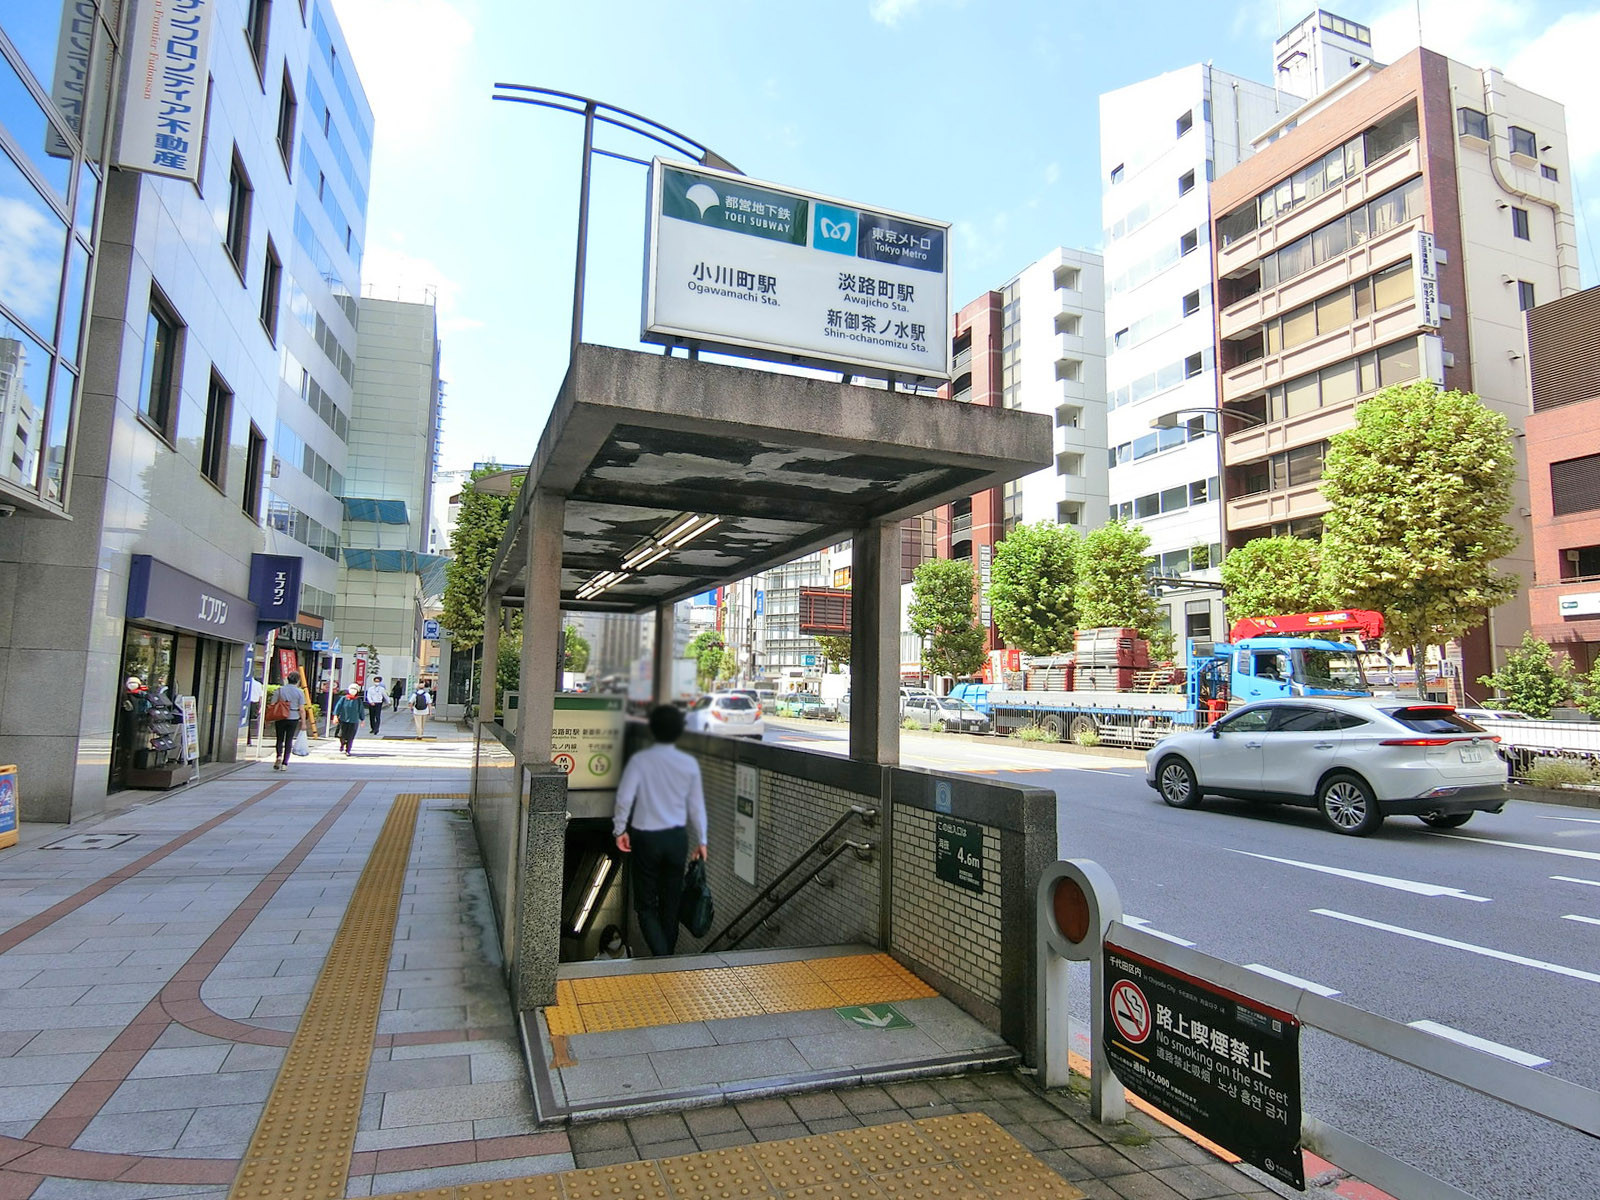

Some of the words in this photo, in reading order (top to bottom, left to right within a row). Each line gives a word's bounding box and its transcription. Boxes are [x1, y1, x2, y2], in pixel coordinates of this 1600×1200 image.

[149, 10, 164, 52] Frontier
[144, 52, 159, 100] Fudousan
[724, 195, 791, 221] 都営地下鉄
[724, 212, 747, 224] TOEI
[749, 216, 791, 234] SUBWAY
[871, 227, 931, 250] 東京メトロ
[875, 242, 901, 256] Tokyo
[901, 248, 928, 261] Metro
[692, 261, 777, 295] 小川町駅
[838, 272, 914, 303] 淡路町駅
[687, 281, 758, 303] Ogawamachi
[761, 295, 781, 307] Sta.
[843, 293, 889, 309] Awajicho
[891, 301, 910, 313] Sta.
[824, 327, 908, 350] Shin-ochanomizu
[910, 342, 929, 353] Sta.
[827, 308, 926, 342] 新御茶ノ水駅
[271, 571, 287, 606] エフワン
[198, 594, 229, 624] エフワン
[241, 643, 253, 725] エフワン
[957, 847, 980, 868] 4.6m
[1109, 956, 1142, 978] 千代田区内
[1156, 1003, 1272, 1079] 路上喫煙禁止
[1156, 1029, 1170, 1046] No
[1171, 1039, 1213, 1071] smoking
[1215, 1061, 1230, 1077] on
[1231, 1067, 1251, 1088] the
[1253, 1080, 1289, 1107] street
[1217, 1077, 1238, 1099] 노상
[1265, 1101, 1288, 1126] 금지
